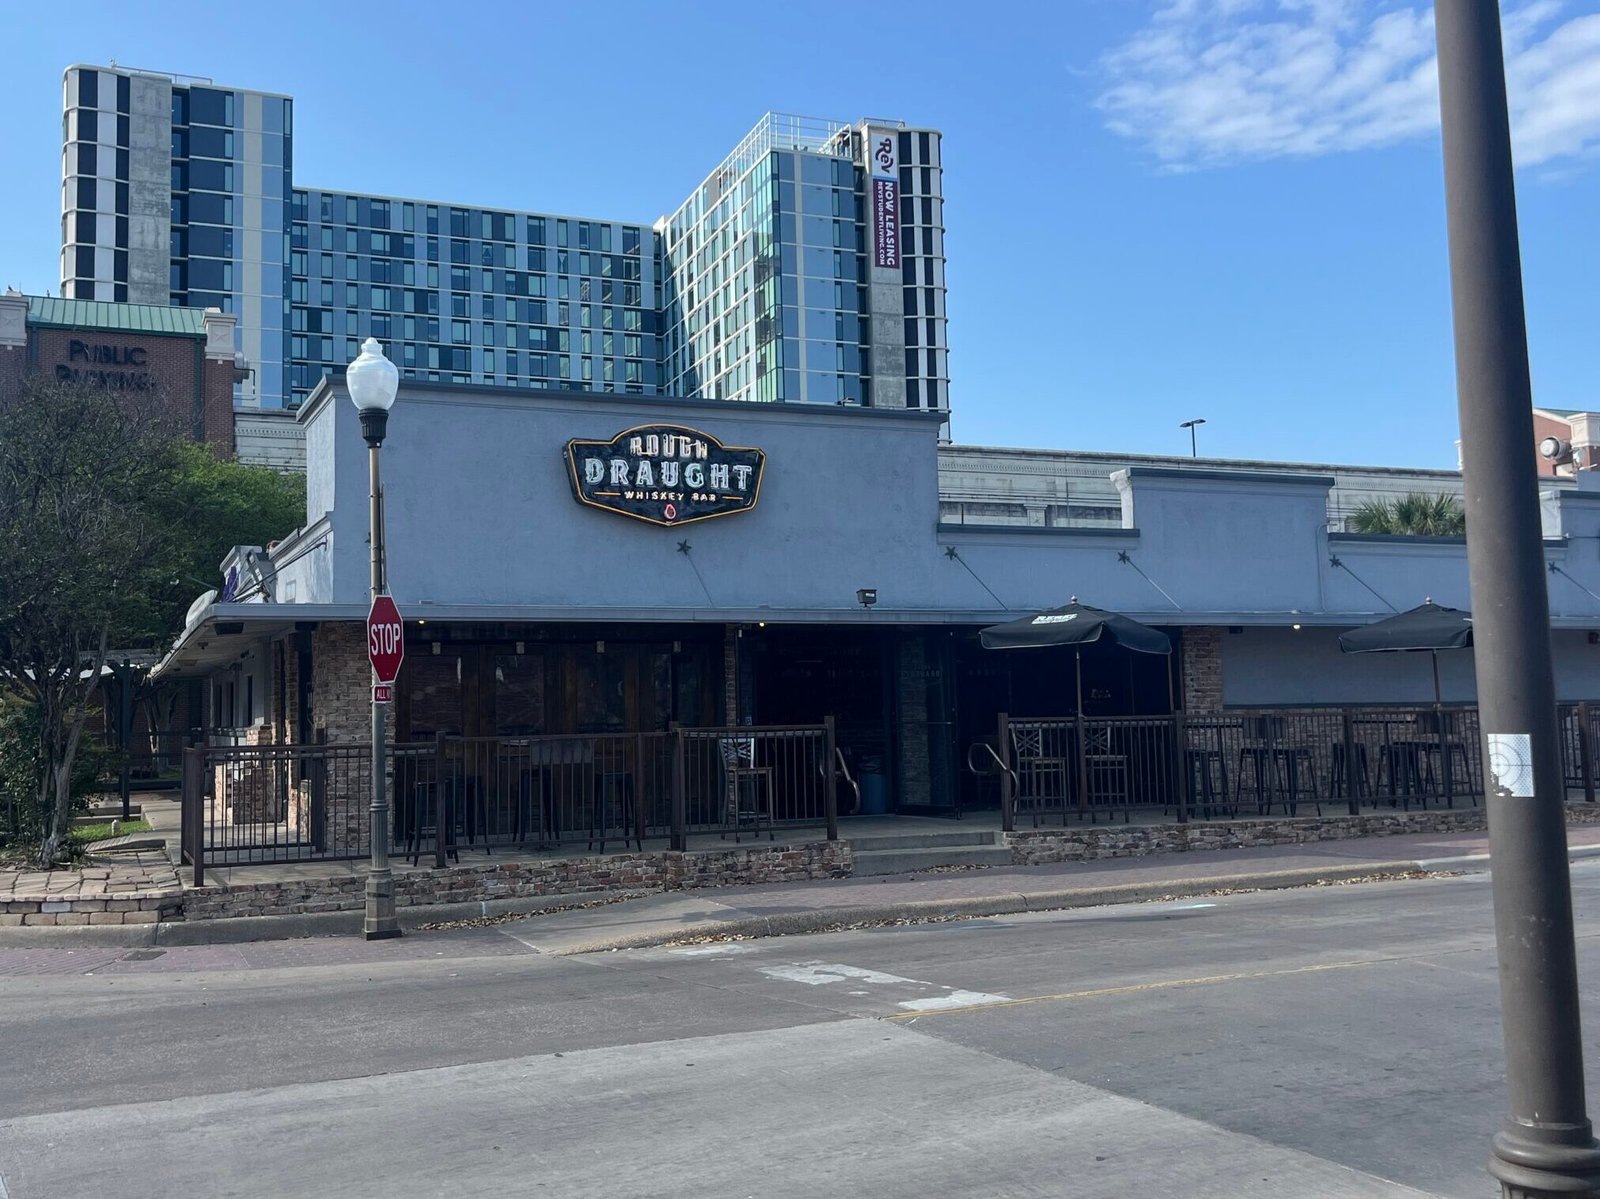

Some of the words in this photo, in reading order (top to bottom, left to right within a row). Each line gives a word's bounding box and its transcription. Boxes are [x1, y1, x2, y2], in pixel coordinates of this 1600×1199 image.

[875, 138, 894, 173] Rev
[885, 182, 894, 212] NOW
[877, 181, 885, 266] REVSTUDENTLIVING.COM
[886, 215, 895, 266] LEASING
[629, 434, 708, 459] ROUGH
[584, 458, 753, 490] DRAUGHT
[624, 491, 684, 501] WHISKEY
[692, 492, 717, 502] BAR
[371, 623, 401, 656] STOP
[376, 688, 386, 699] ALL
